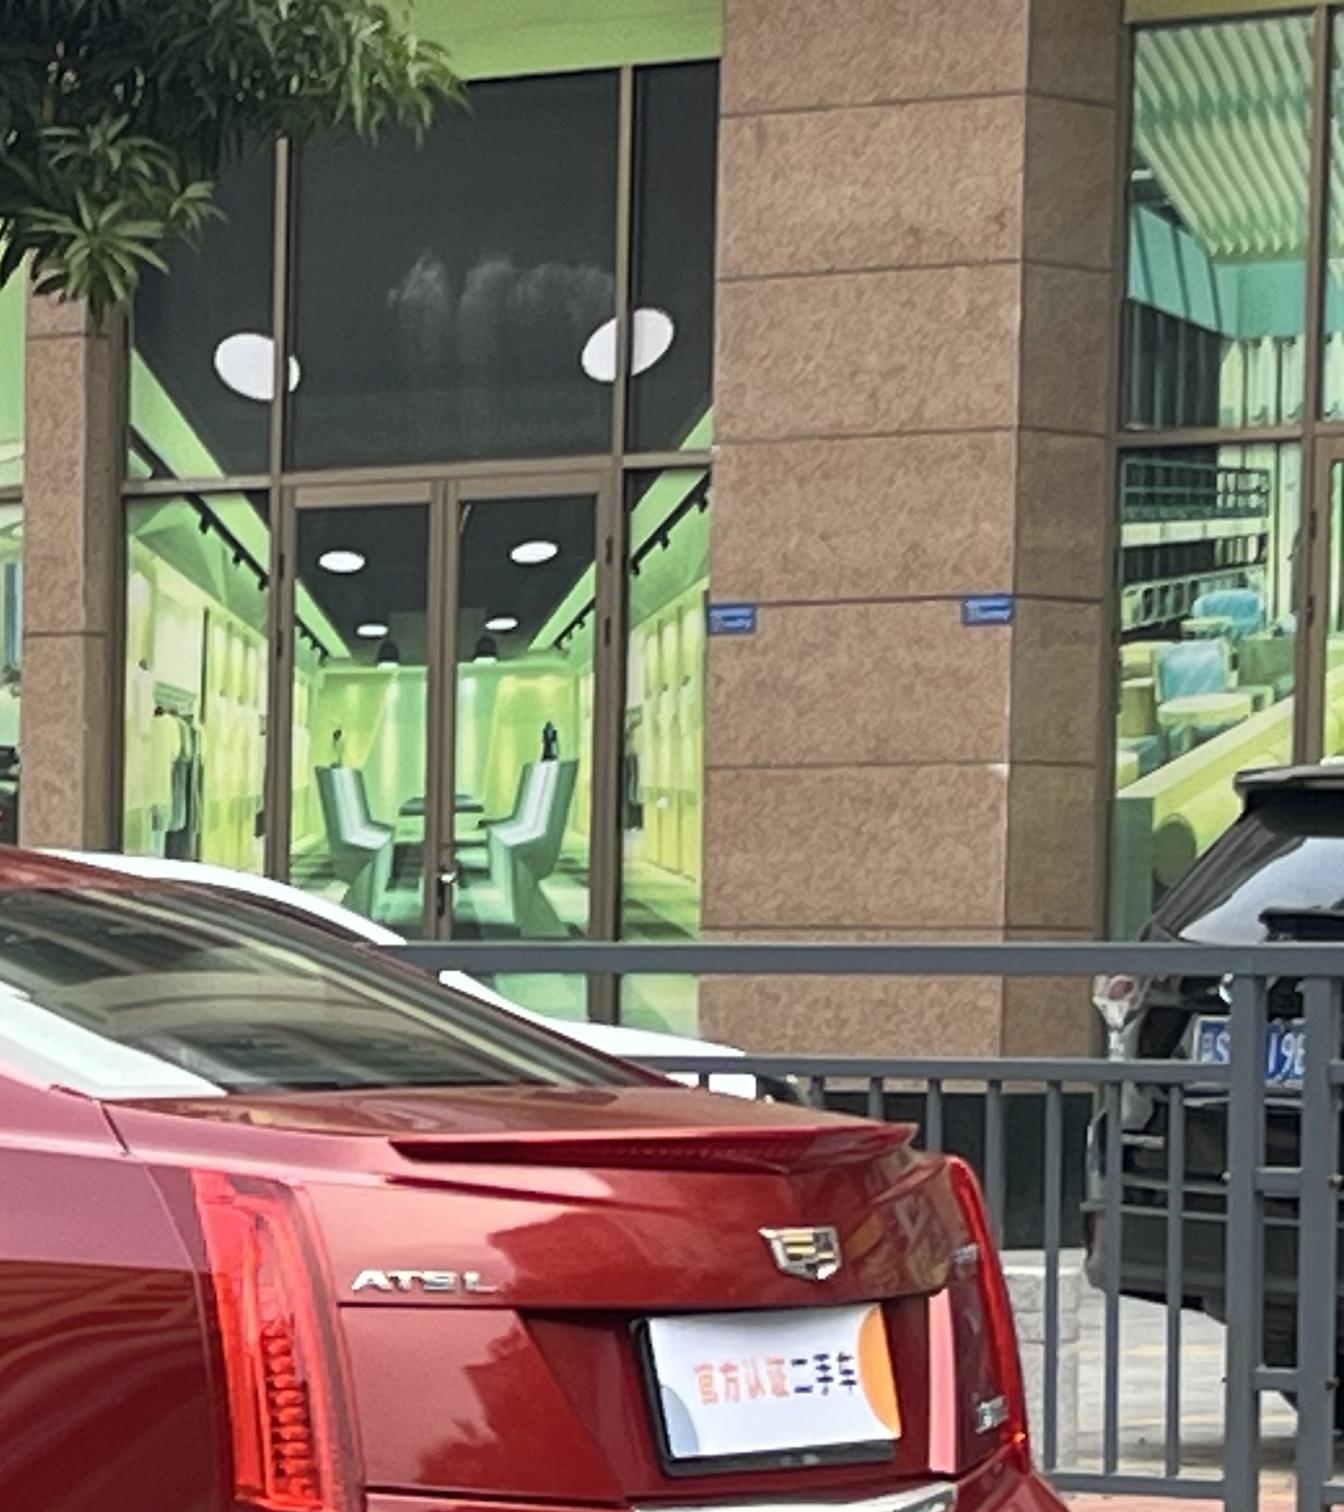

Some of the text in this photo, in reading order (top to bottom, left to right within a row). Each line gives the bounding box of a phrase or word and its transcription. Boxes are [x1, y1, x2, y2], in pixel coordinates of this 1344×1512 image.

[692, 1351, 858, 1405] 官方认证二手车
